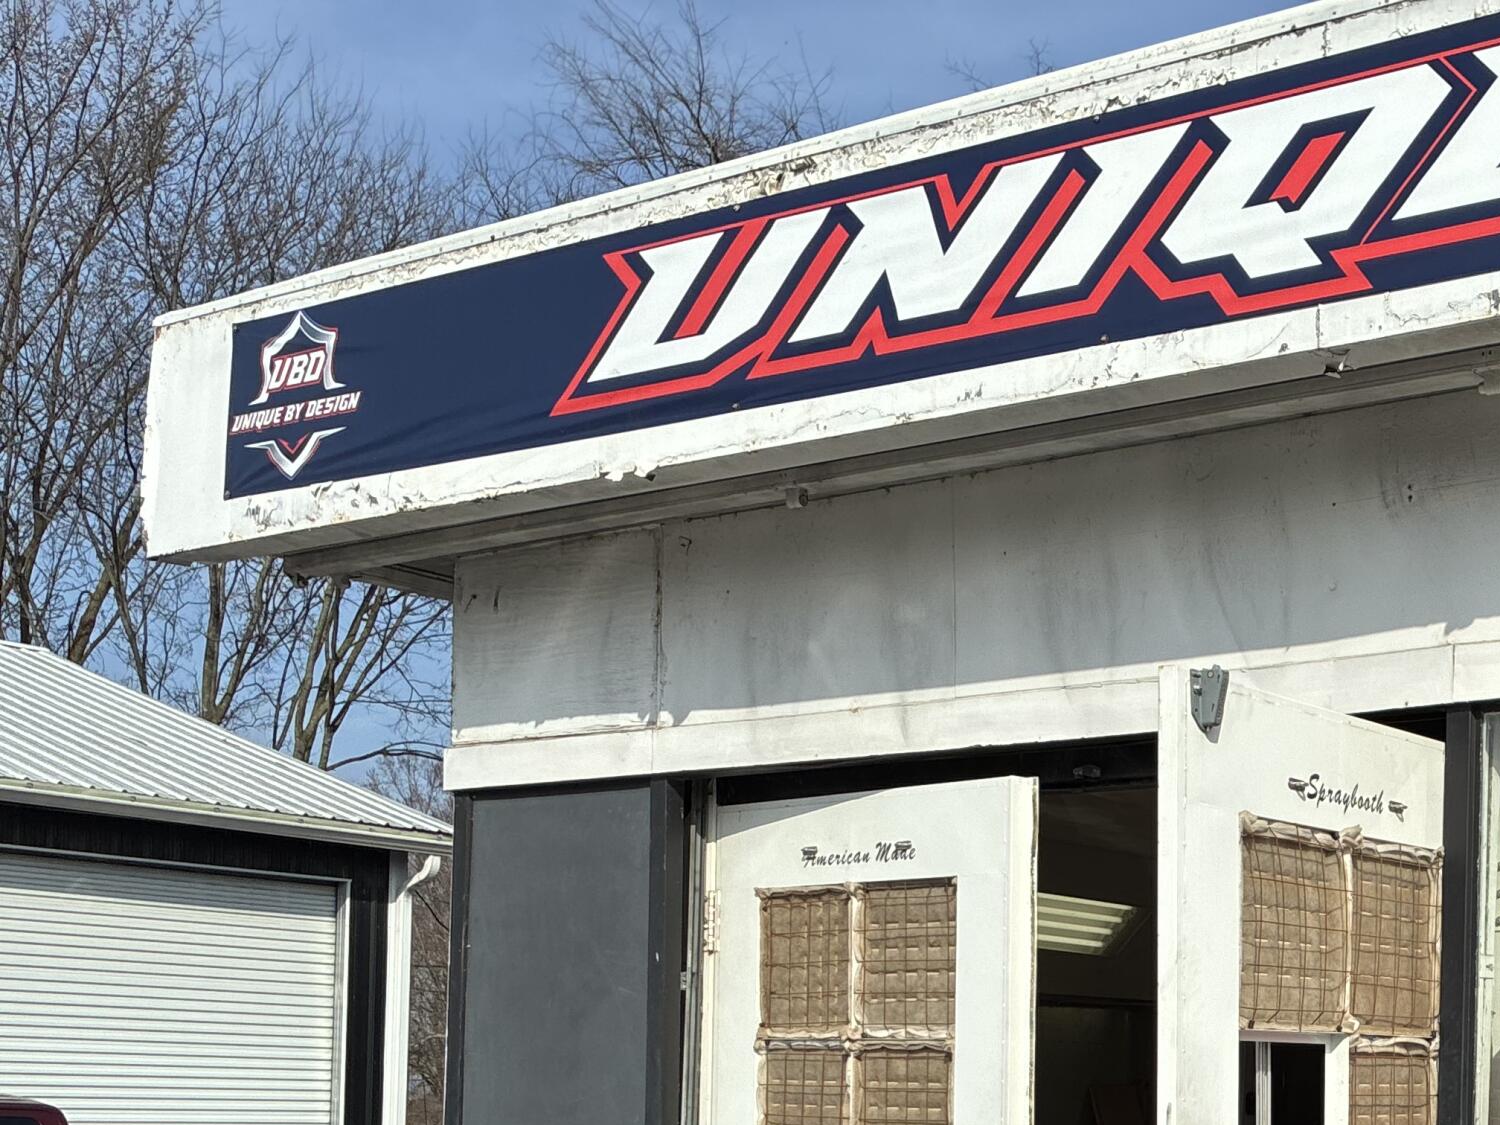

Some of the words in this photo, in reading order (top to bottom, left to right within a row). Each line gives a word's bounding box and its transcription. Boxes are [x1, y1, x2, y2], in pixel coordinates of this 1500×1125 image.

[268, 349, 327, 391] UBD
[231, 406, 284, 433] UNIQUE
[284, 401, 306, 421] BY
[305, 391, 362, 418] DESIGN
[1307, 773, 1384, 815] Spraybooth
[800, 848, 871, 868] American
